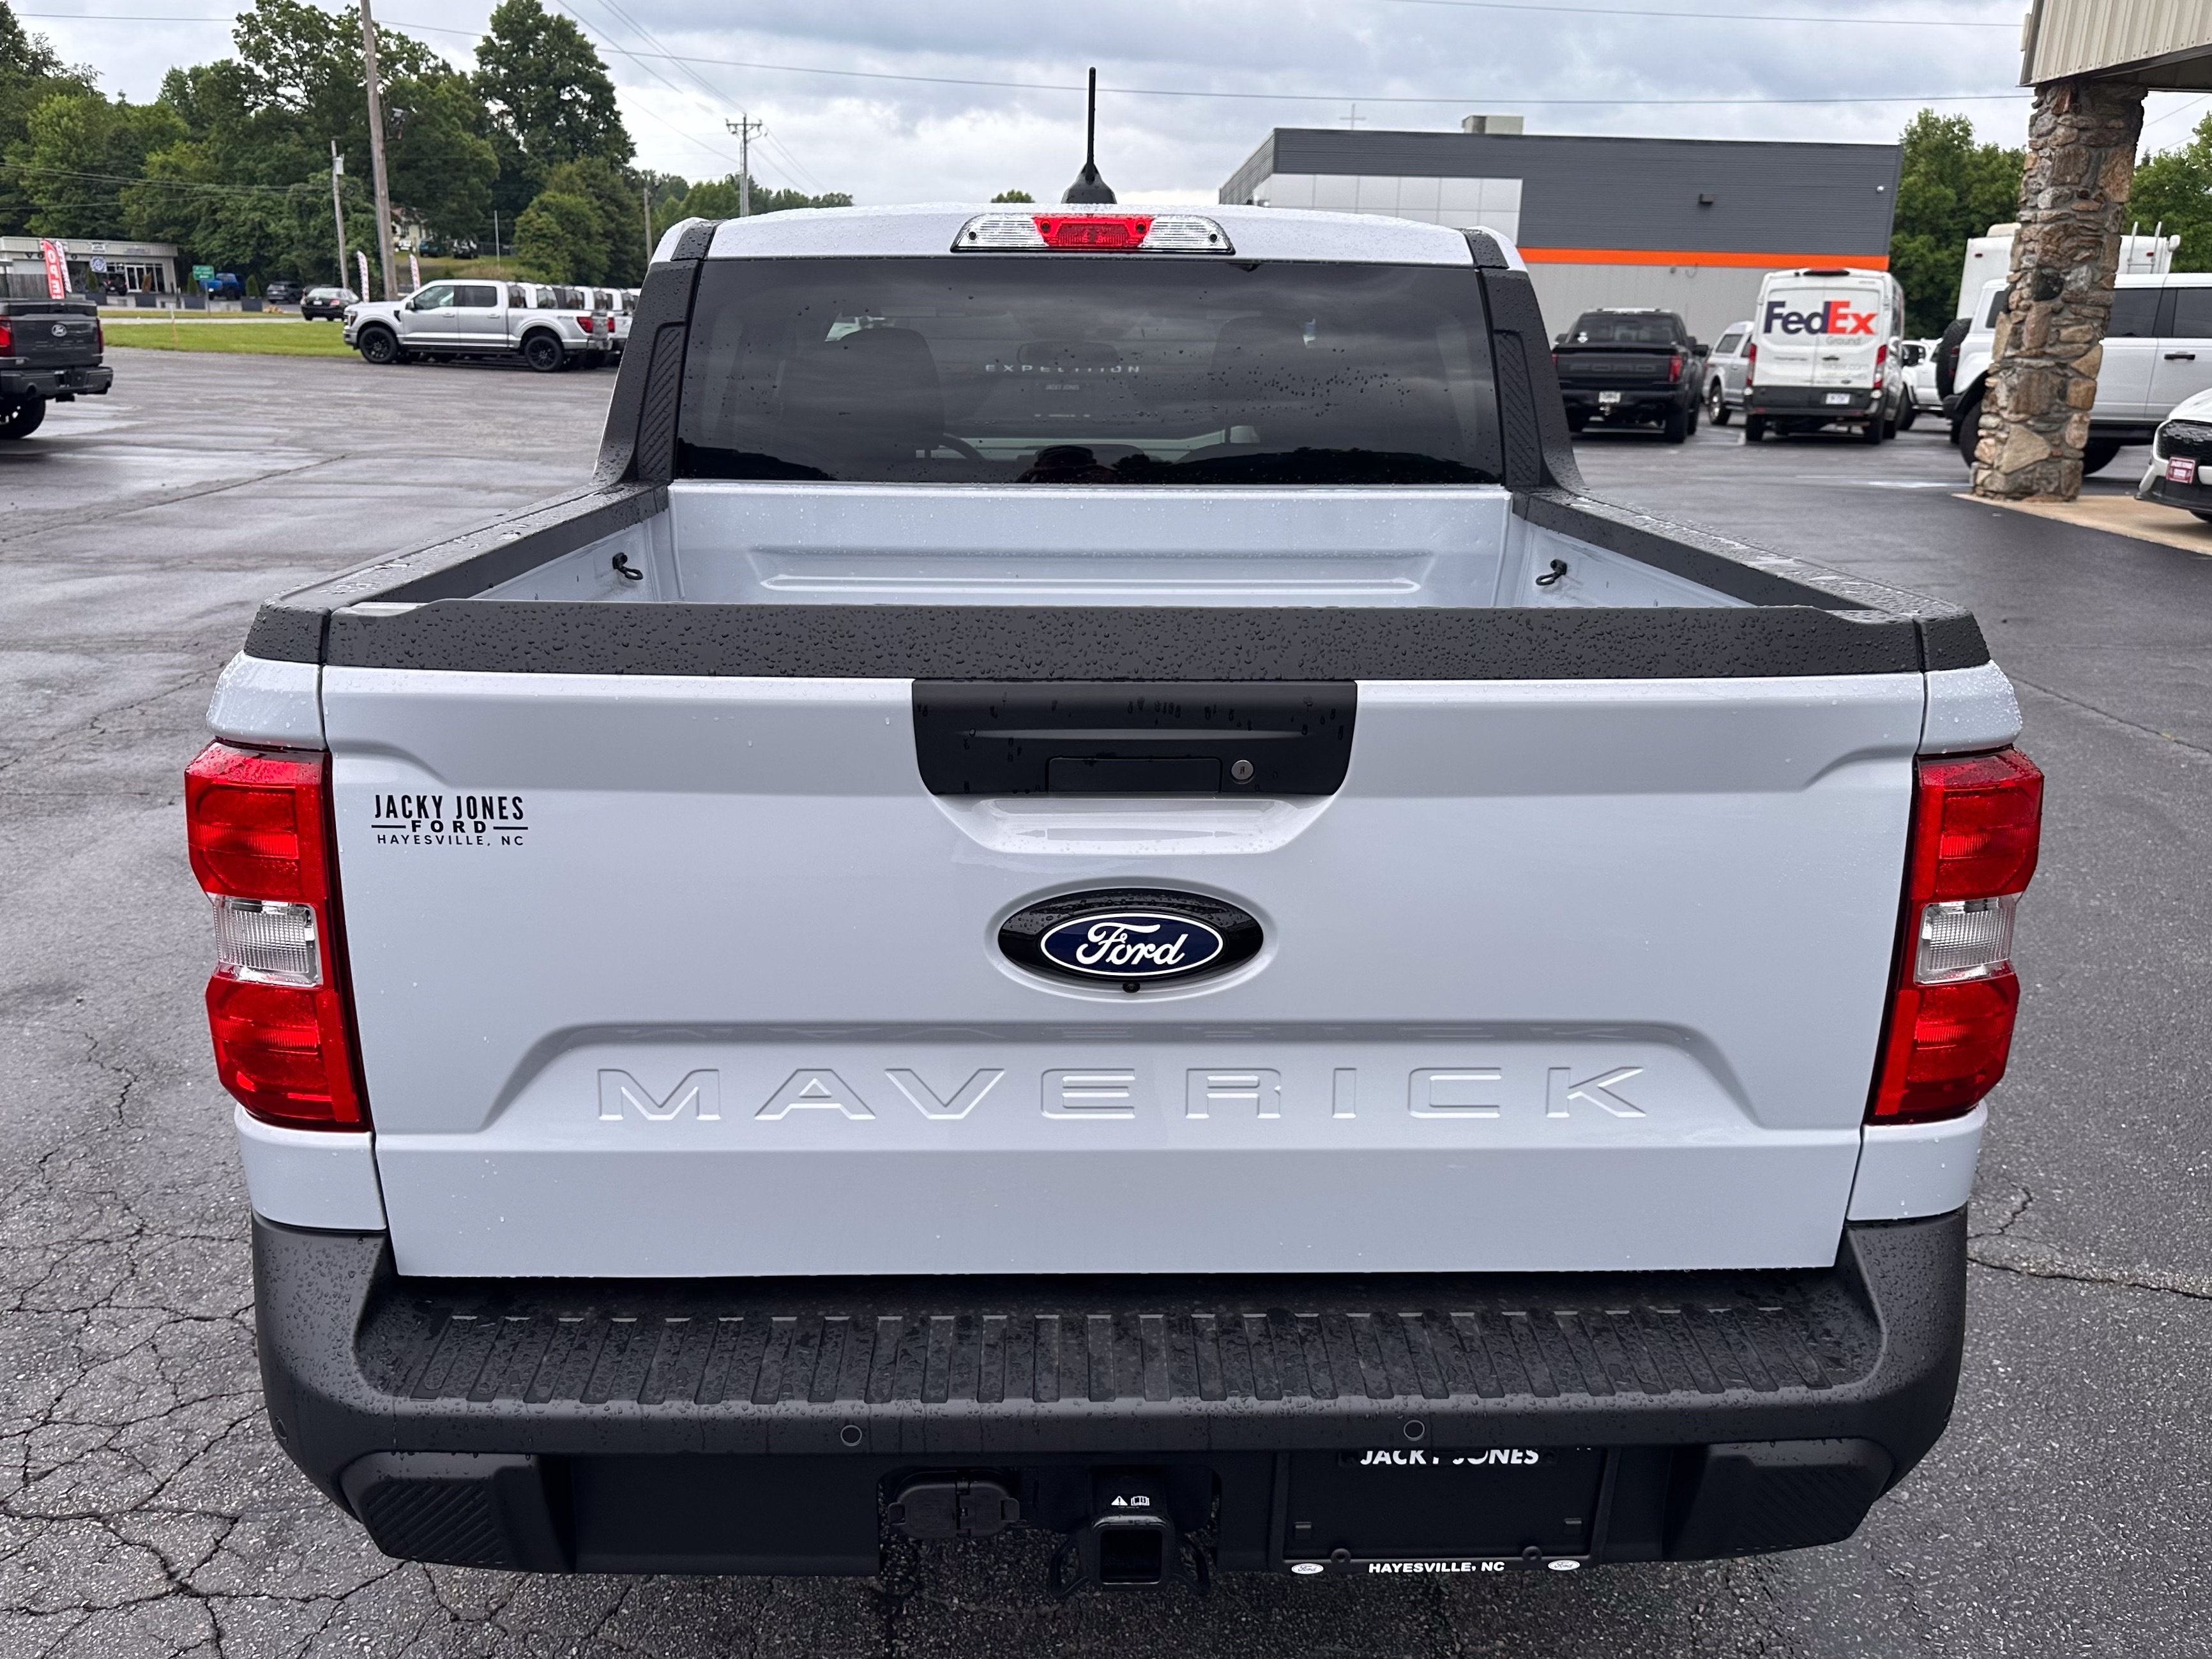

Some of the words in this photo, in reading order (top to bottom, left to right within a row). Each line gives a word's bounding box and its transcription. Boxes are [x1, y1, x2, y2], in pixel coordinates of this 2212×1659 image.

[47, 248, 63, 299] OPE
[1763, 300, 1878, 335] FedEx
[374, 794, 443, 819] JACKY
[456, 796, 524, 821] JONES
[377, 834, 491, 846] HAYESVILLE,
[501, 836, 524, 846] NC
[411, 820, 487, 833] FORD
[1075, 922, 1188, 965] Ford
[598, 1066, 1647, 1120] MAVERICK
[1368, 1562, 1476, 1573] HAYESVILLE,
[1481, 1561, 1505, 1572] NC
